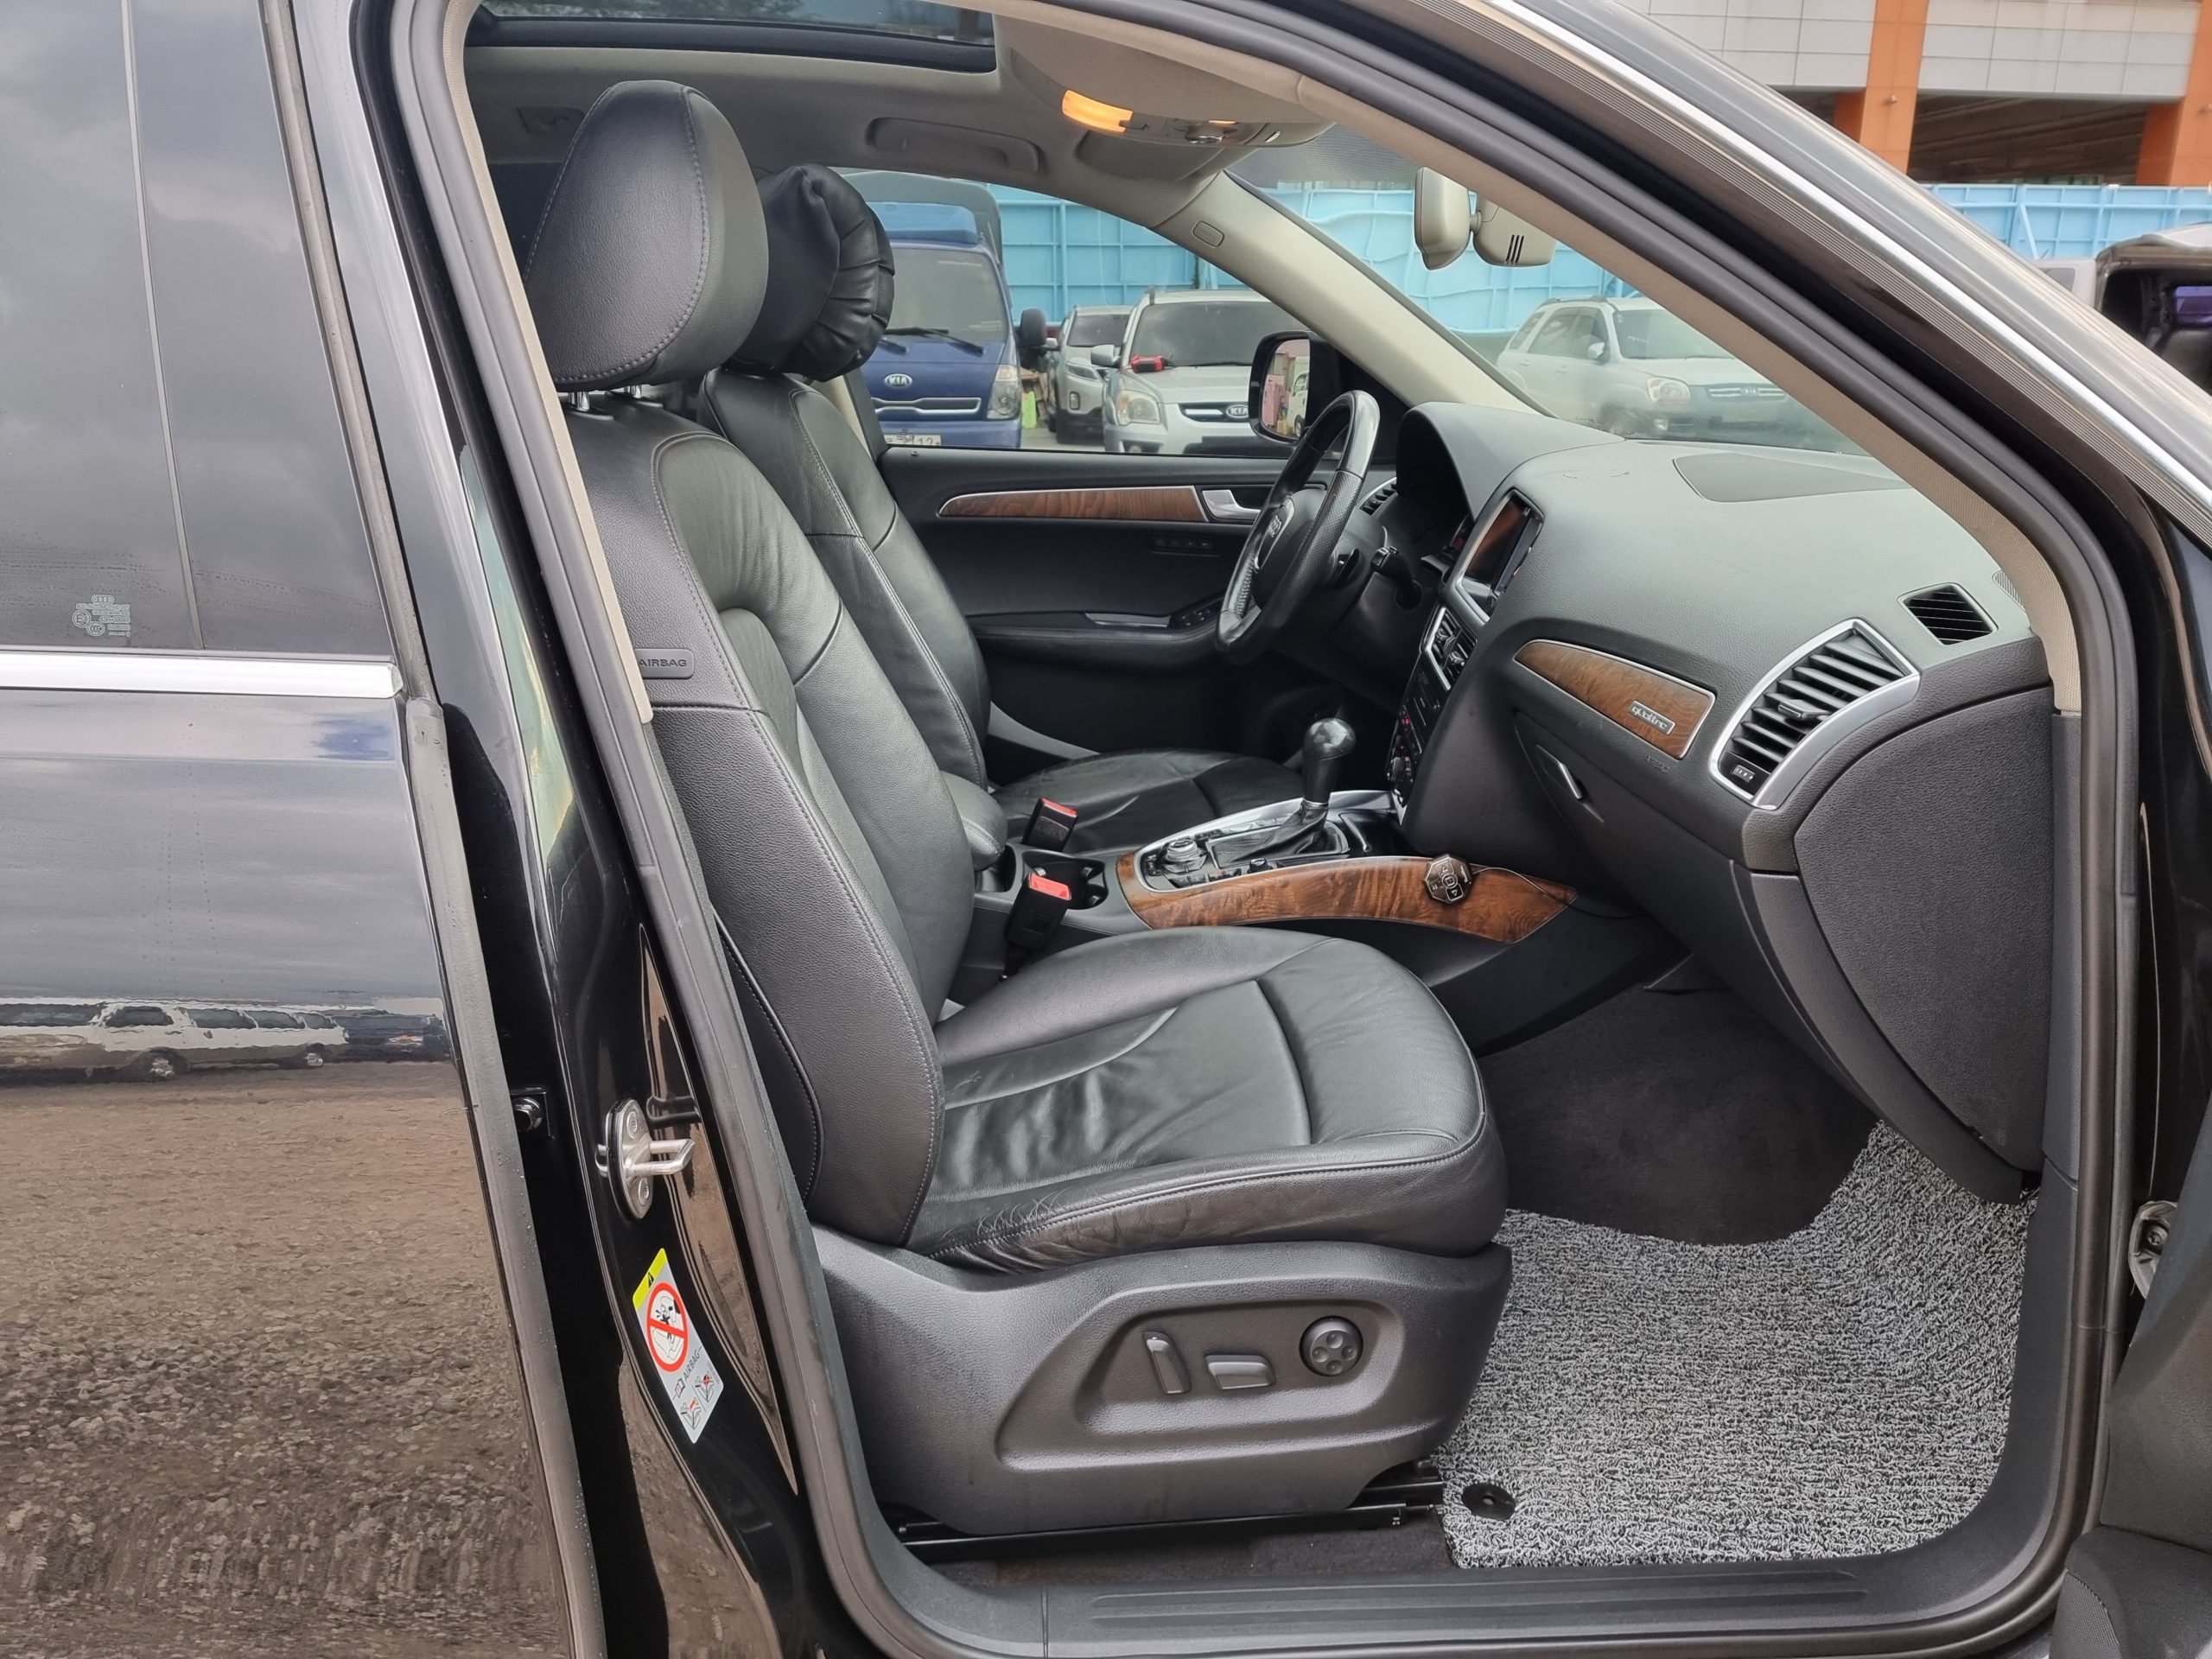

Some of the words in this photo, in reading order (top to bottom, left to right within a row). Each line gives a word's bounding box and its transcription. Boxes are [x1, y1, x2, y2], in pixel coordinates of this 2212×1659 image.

[889, 376, 908, 386] KIA
[639, 658, 687, 667] AIRBAG
[1631, 705, 1668, 730] quattro
[683, 1348, 700, 1382] AIRBAG
